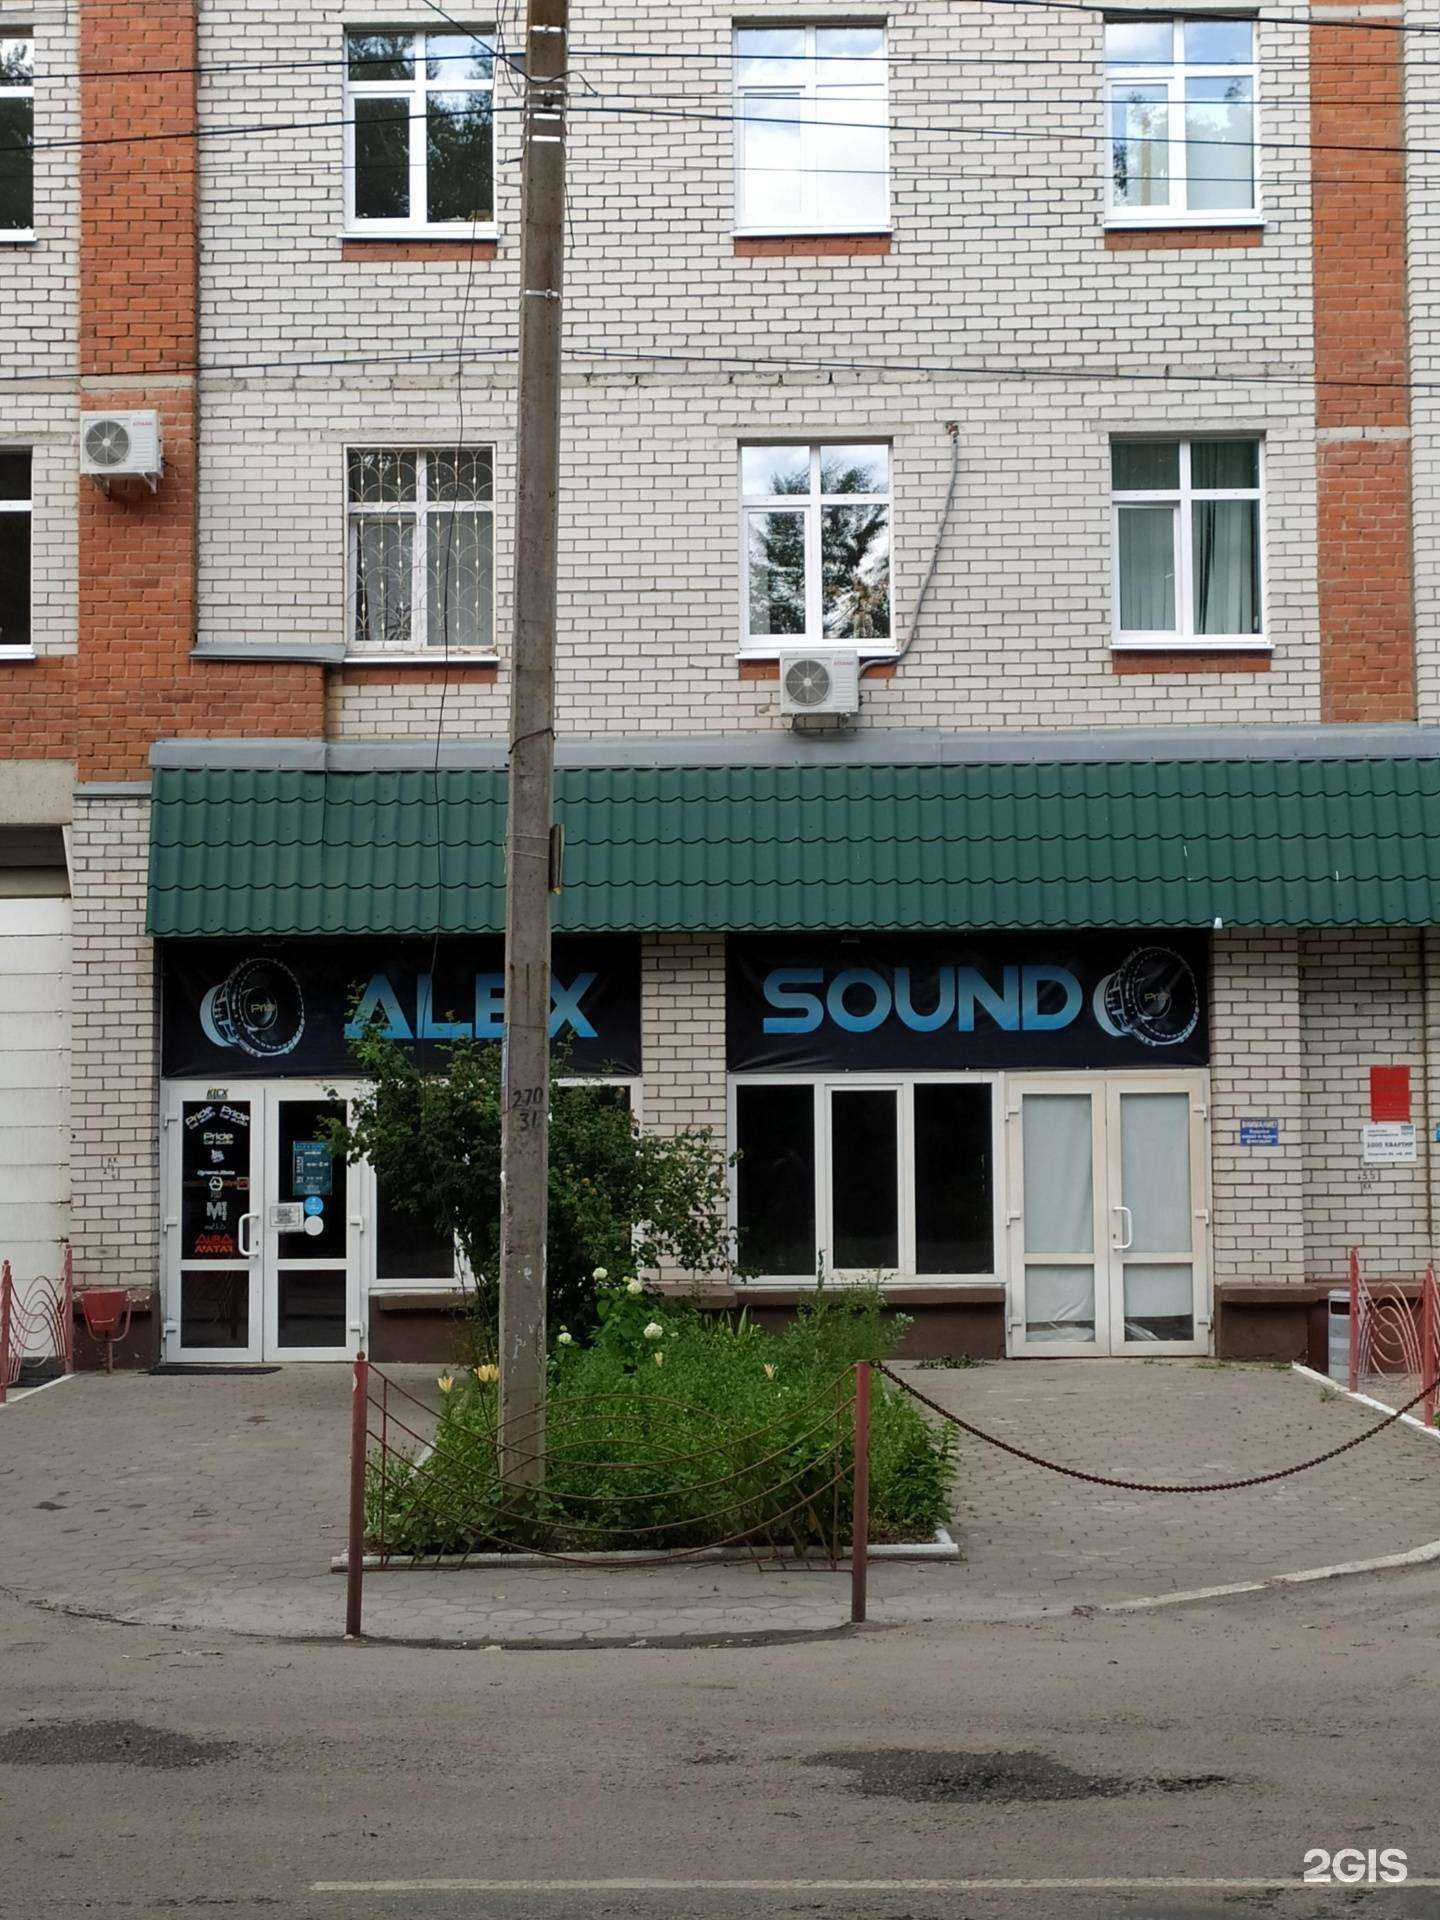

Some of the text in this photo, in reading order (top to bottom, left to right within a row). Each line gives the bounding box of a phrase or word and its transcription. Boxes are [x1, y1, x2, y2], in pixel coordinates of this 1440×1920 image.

[344, 972, 598, 1039] ALEX
[762, 965, 1082, 1034] SOUND
[512, 1087, 544, 1108] 270
[203, 1132, 234, 1141] Pride
